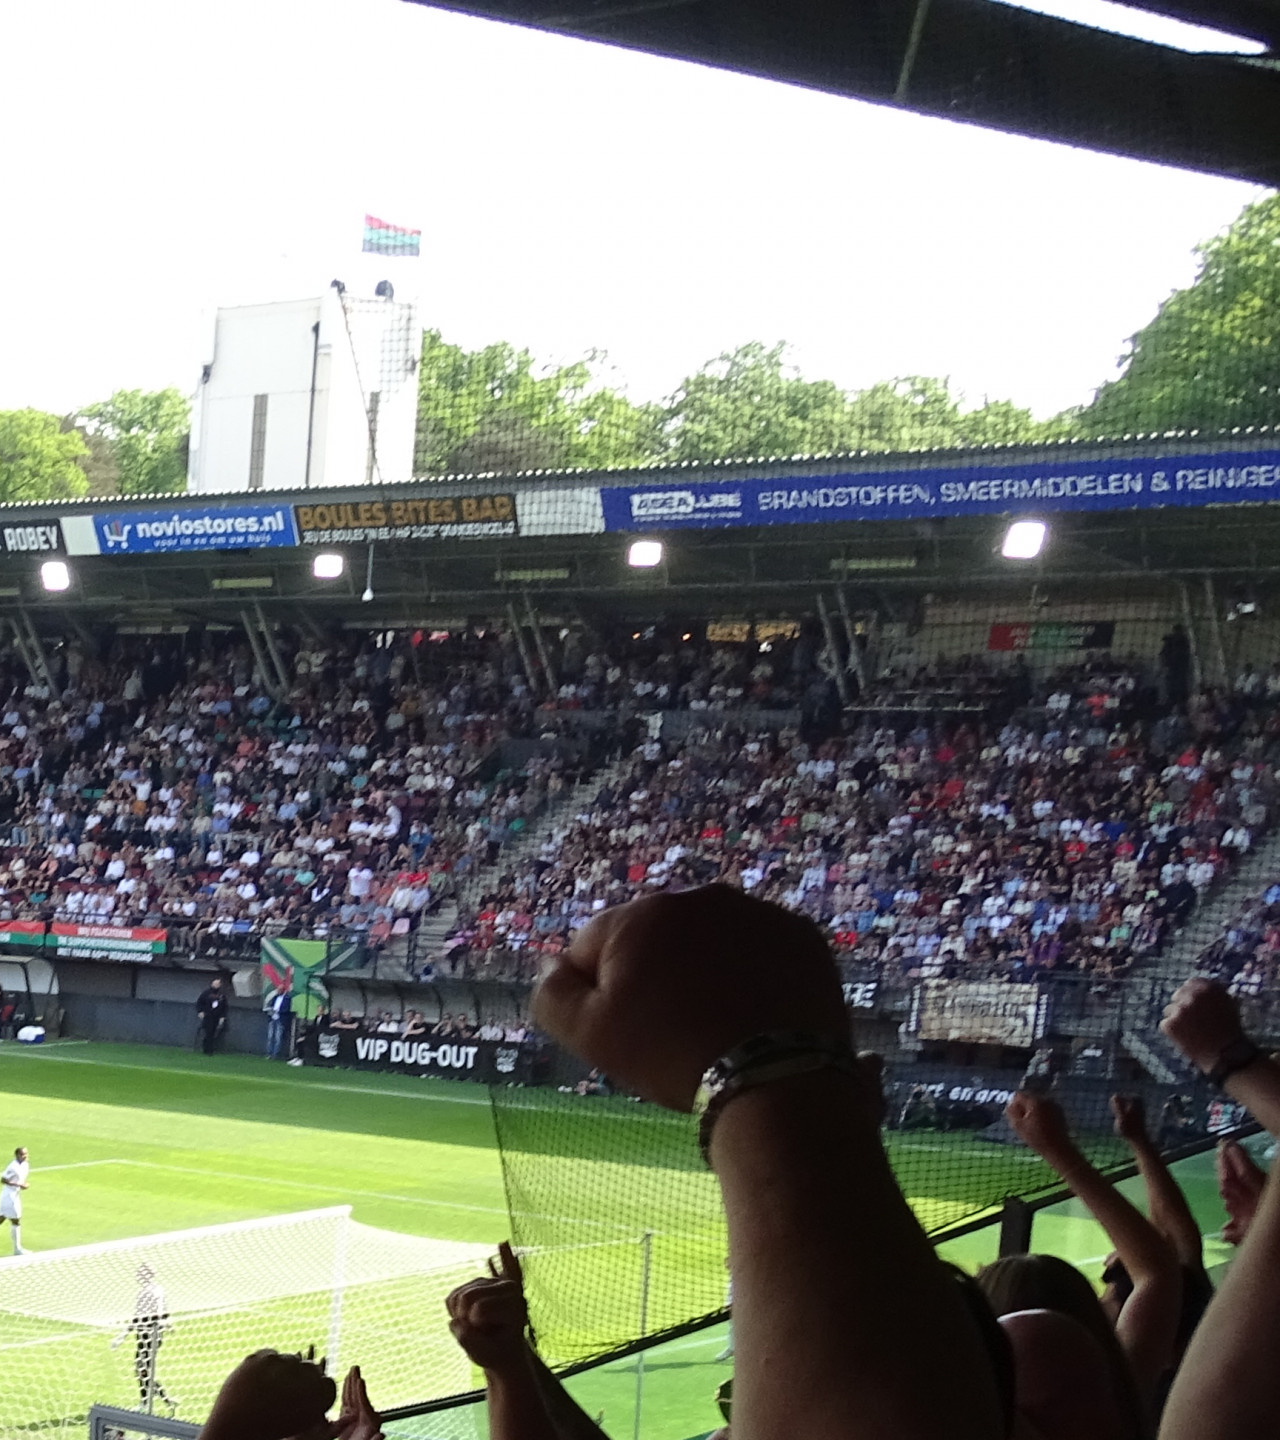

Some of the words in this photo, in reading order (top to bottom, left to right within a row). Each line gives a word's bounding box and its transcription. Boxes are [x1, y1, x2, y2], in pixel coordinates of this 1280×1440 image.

[940, 472, 1143, 502] SMEERMIDDELEN
[1151, 471, 1170, 492] &
[1176, 465, 1280, 492] REINIGE
[136, 511, 284, 538] noviostores.nl
[298, 502, 387, 530] BOULES
[391, 499, 457, 525] BITES
[4, 526, 58, 551] ROBEY
[180, 536, 191, 546] in
[355, 1037, 386, 1061] VIP
[390, 1040, 479, 1070] DUG-OUT
